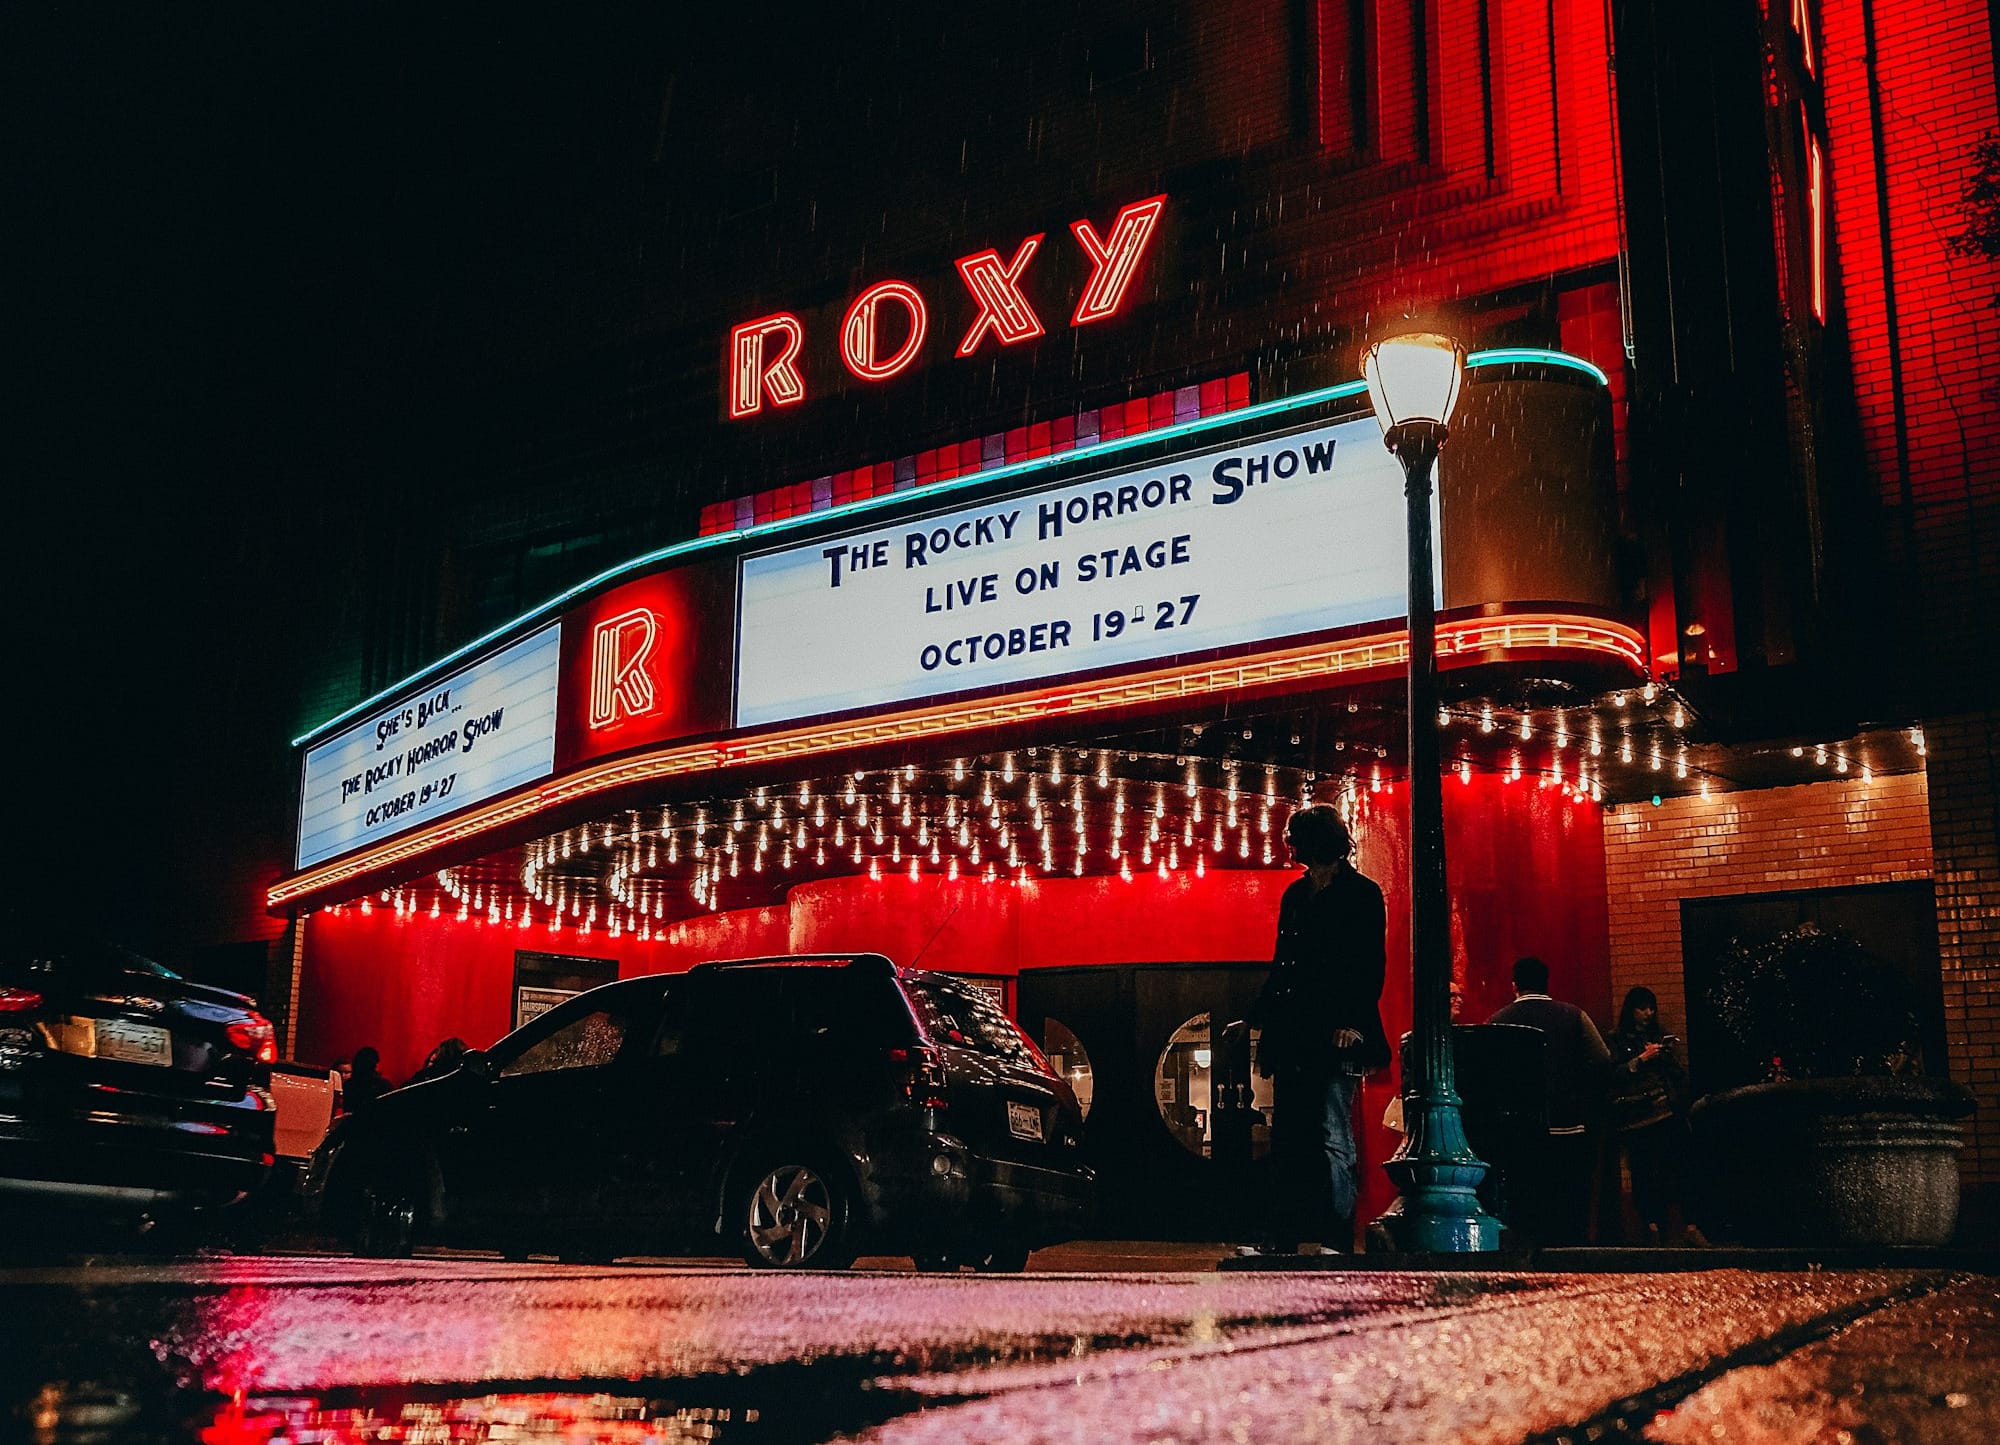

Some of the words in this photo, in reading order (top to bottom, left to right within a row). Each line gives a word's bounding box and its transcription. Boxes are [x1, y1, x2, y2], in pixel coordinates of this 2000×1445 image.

[730, 193, 1168, 419] ROXY
[822, 544, 890, 588] THE
[905, 511, 1021, 570] ROCKY
[1038, 474, 1192, 541] HORROR
[1212, 440, 1337, 505] SHOW
[925, 573, 999, 614] LIVE
[1015, 561, 1060, 595] ON
[1077, 535, 1191, 582] STAGE
[590, 606, 662, 731] R
[920, 620, 1072, 671] OCTOBER
[341, 773, 363, 805] THE
[364, 753, 404, 795] ROCKY
[406, 730, 459, 777] HORROR
[461, 707, 505, 753] SHOW
[375, 709, 413, 751] SHE'S
[365, 790, 416, 828] OCTOBER
